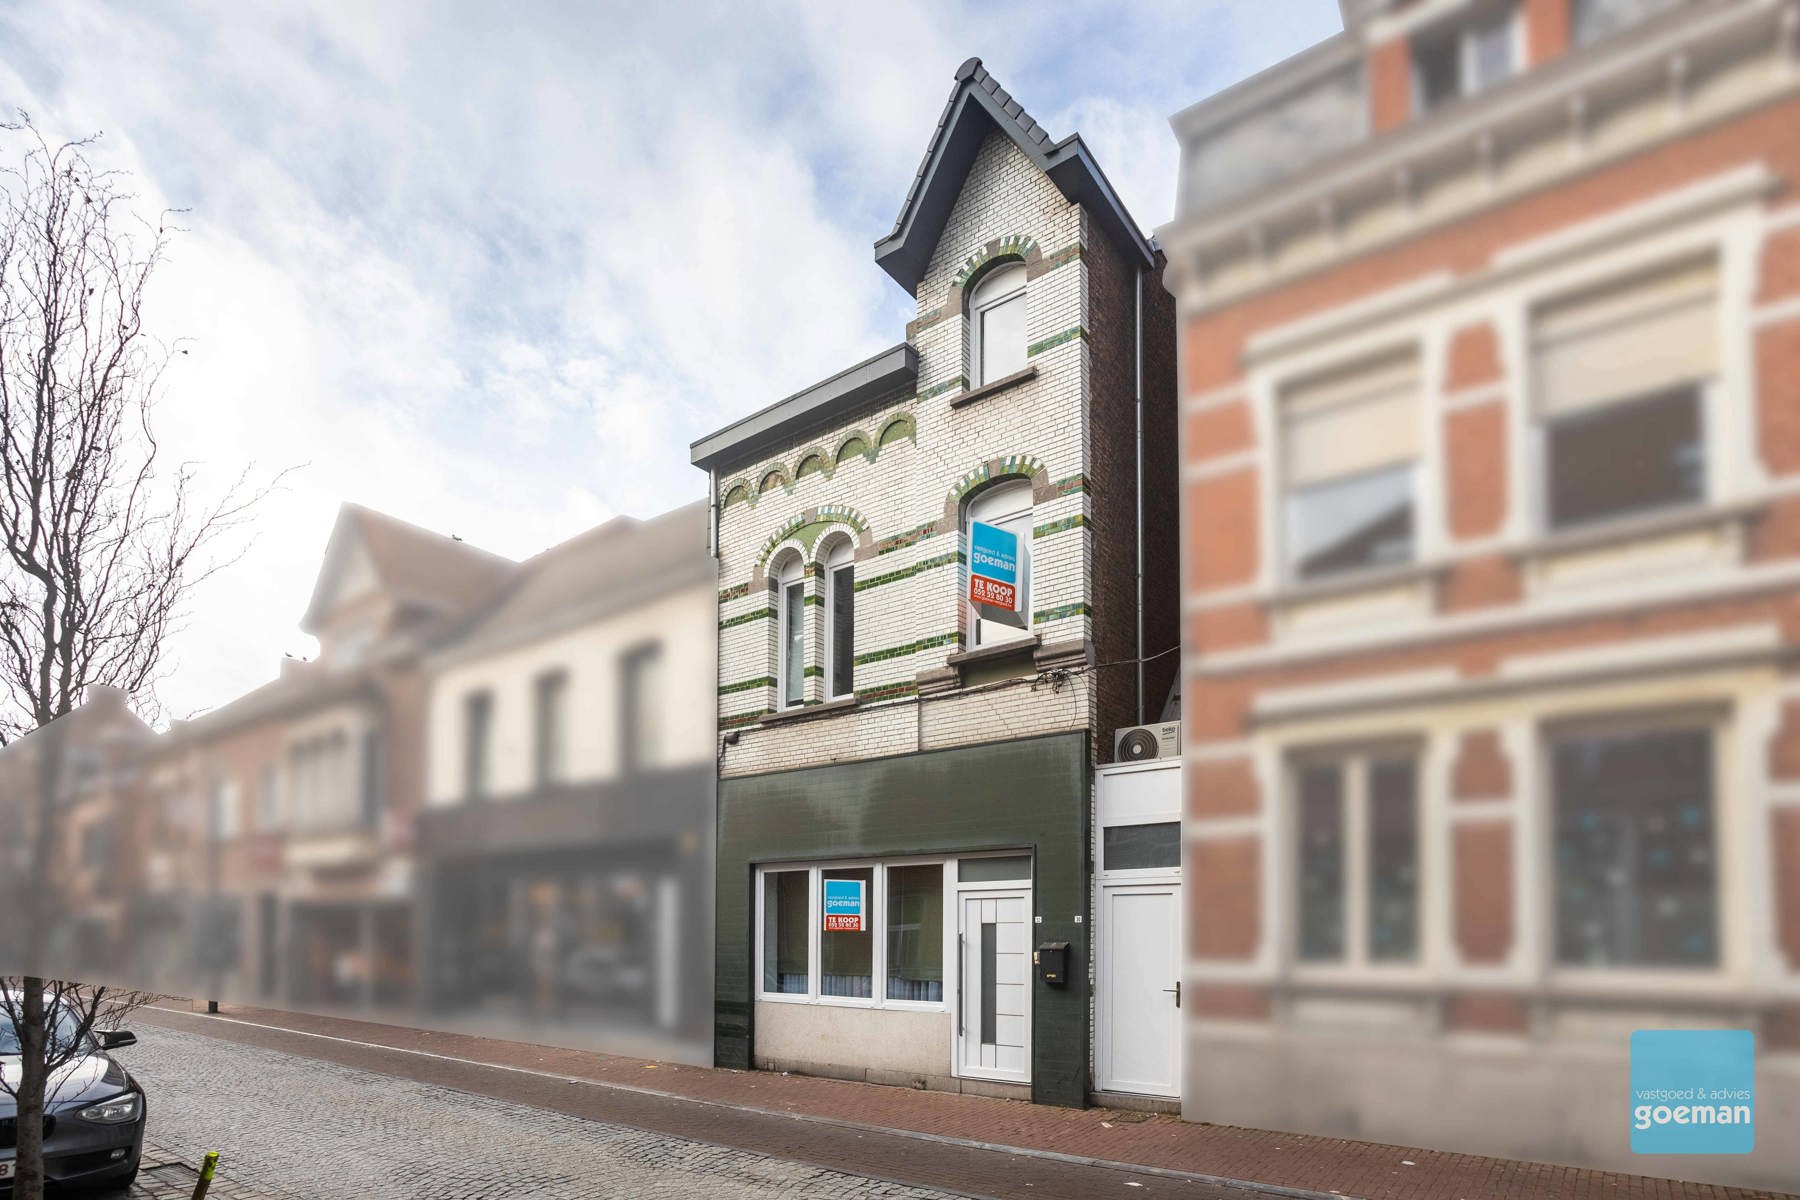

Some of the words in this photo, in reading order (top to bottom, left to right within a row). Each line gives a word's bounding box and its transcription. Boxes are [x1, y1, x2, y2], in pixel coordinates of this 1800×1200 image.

[973, 551, 1015, 572] goeman
[973, 588, 986, 597] 052
[974, 579, 984, 589] TE
[986, 582, 1012, 597] KOOP
[827, 900, 860, 908] goeman
